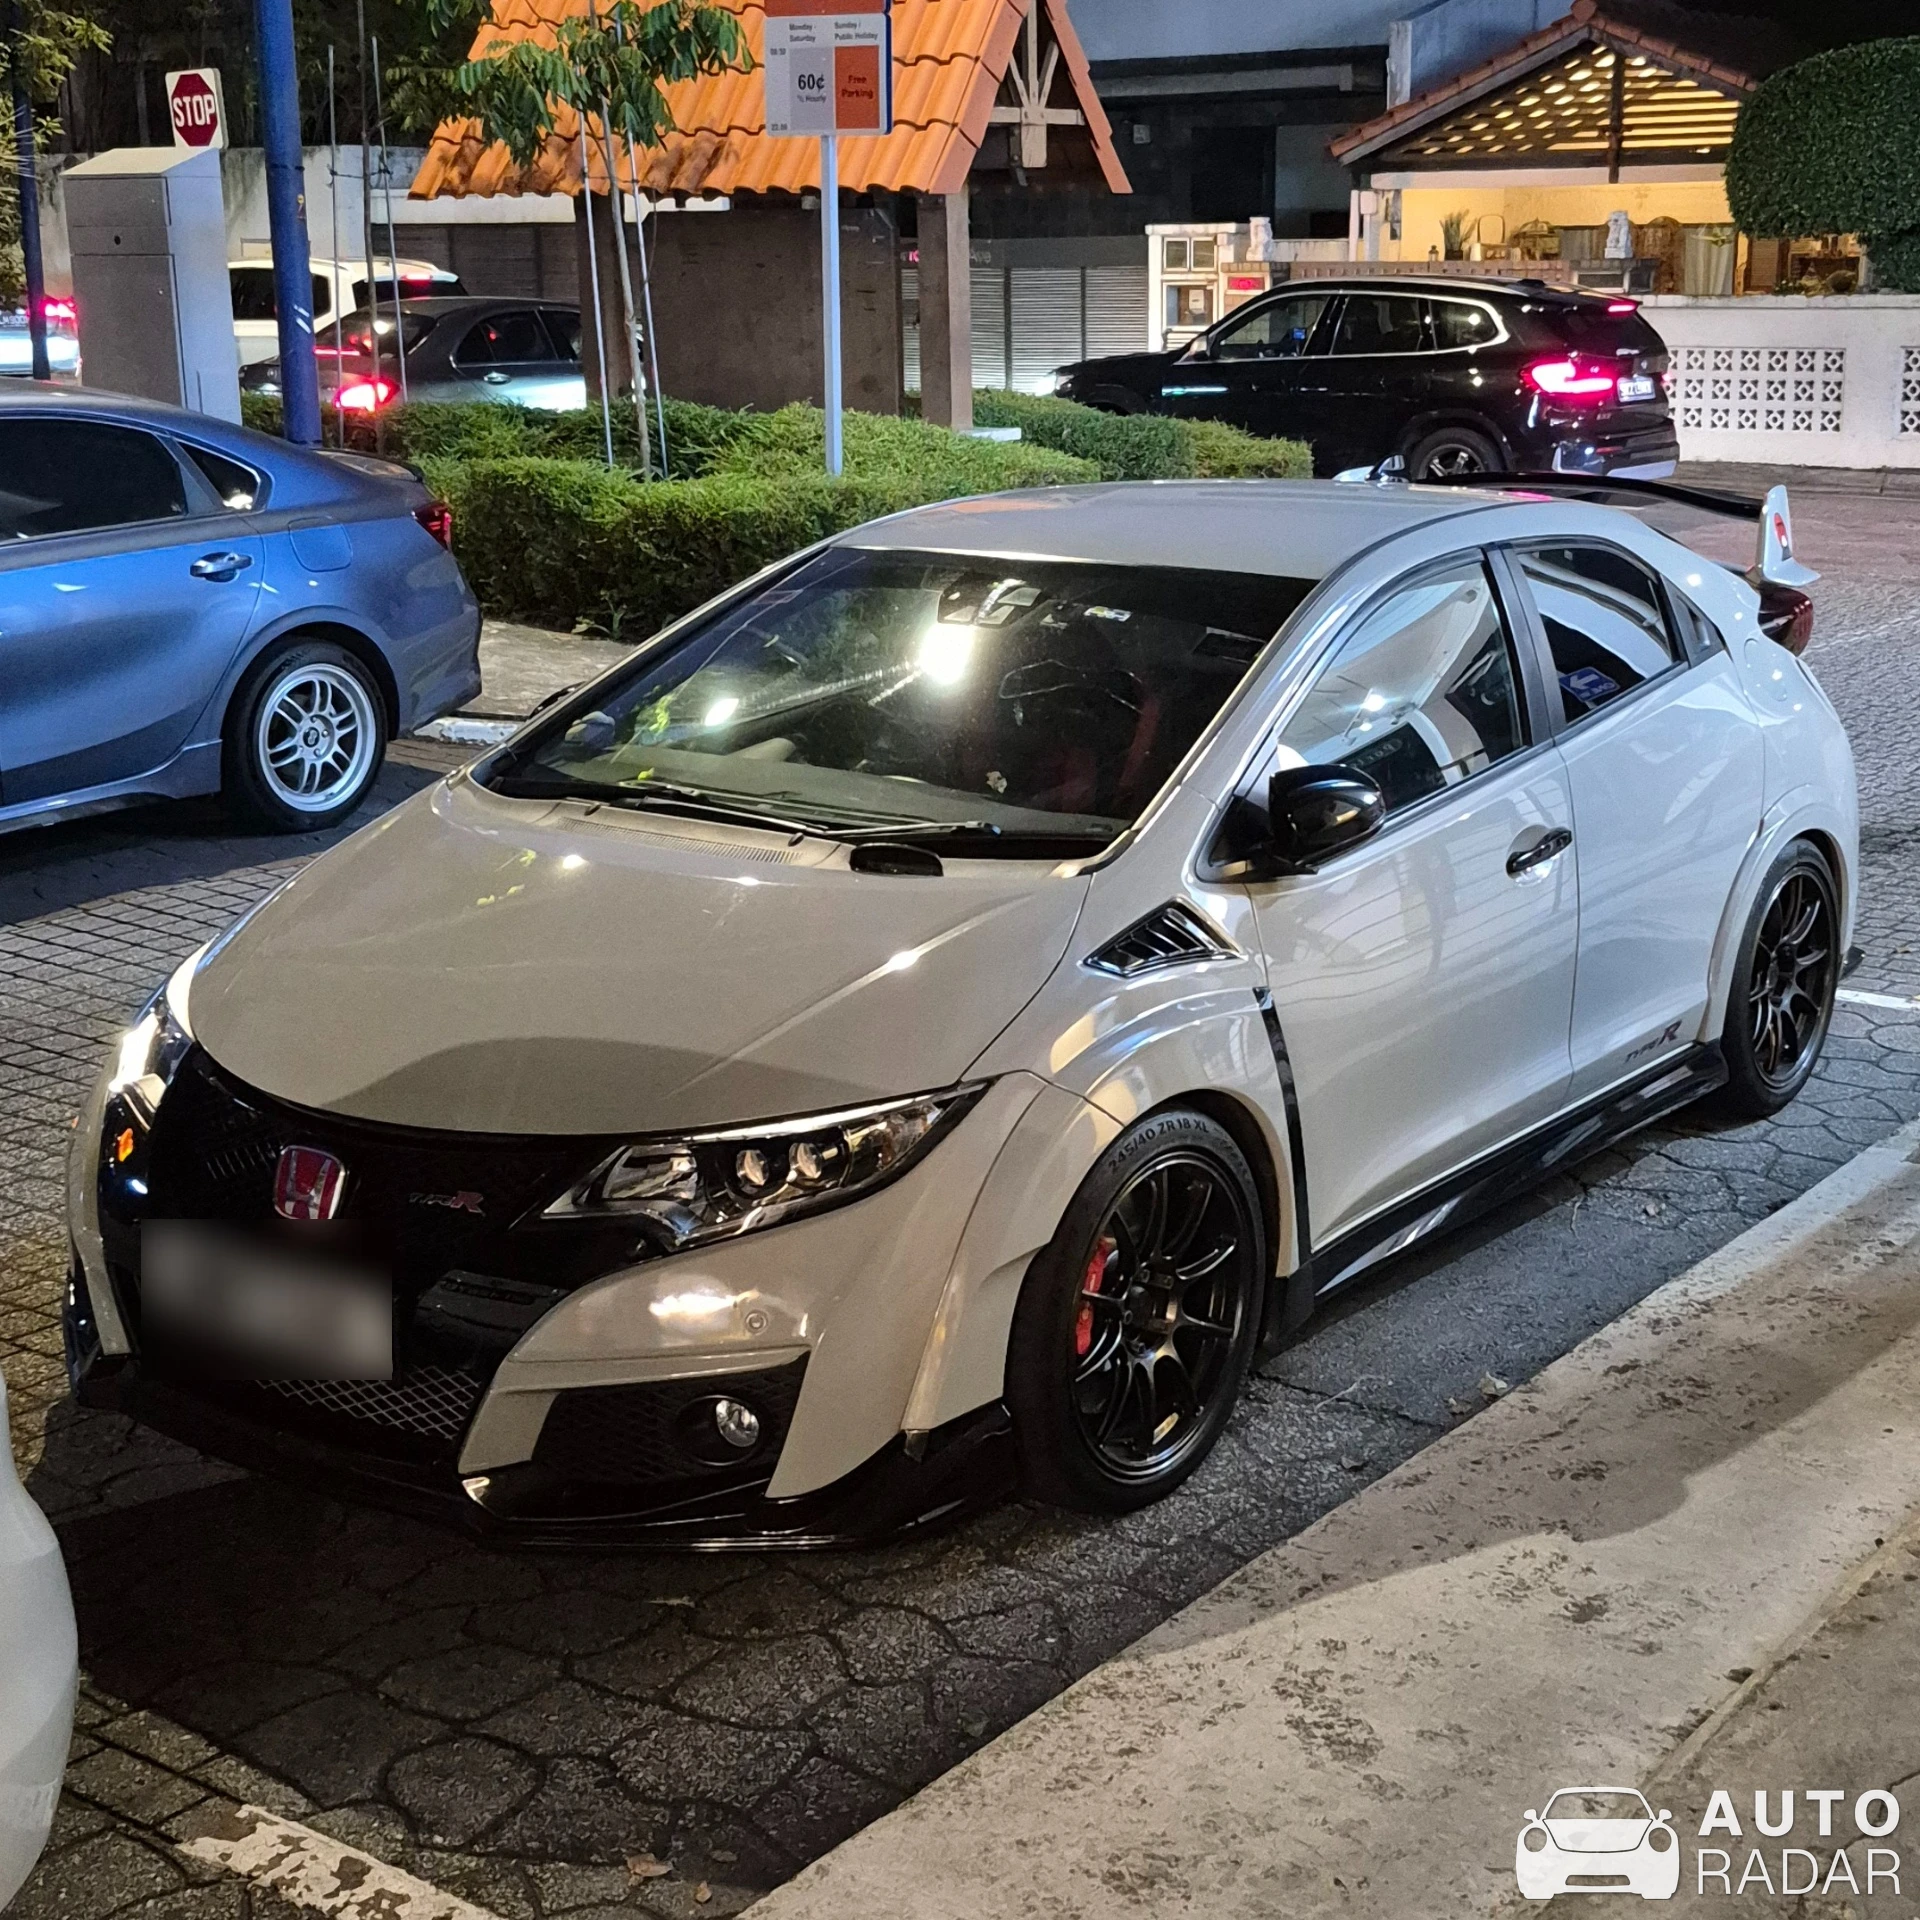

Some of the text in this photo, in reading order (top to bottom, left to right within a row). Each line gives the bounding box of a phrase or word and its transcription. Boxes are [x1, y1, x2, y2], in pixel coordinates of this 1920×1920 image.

[789, 23, 813, 32] Monday
[834, 21, 857, 30] Sunday
[789, 34, 816, 43] Saturday
[834, 32, 878, 40] Public Holiday
[798, 73, 825, 92] 60¢
[848, 74, 867, 84] Free
[841, 88, 873, 99] Parking
[805, 94, 826, 103] Hourly
[173, 94, 216, 127] STOP
[1109, 1128, 1156, 1170] 245/40
[1194, 1118, 1209, 1133] XL
